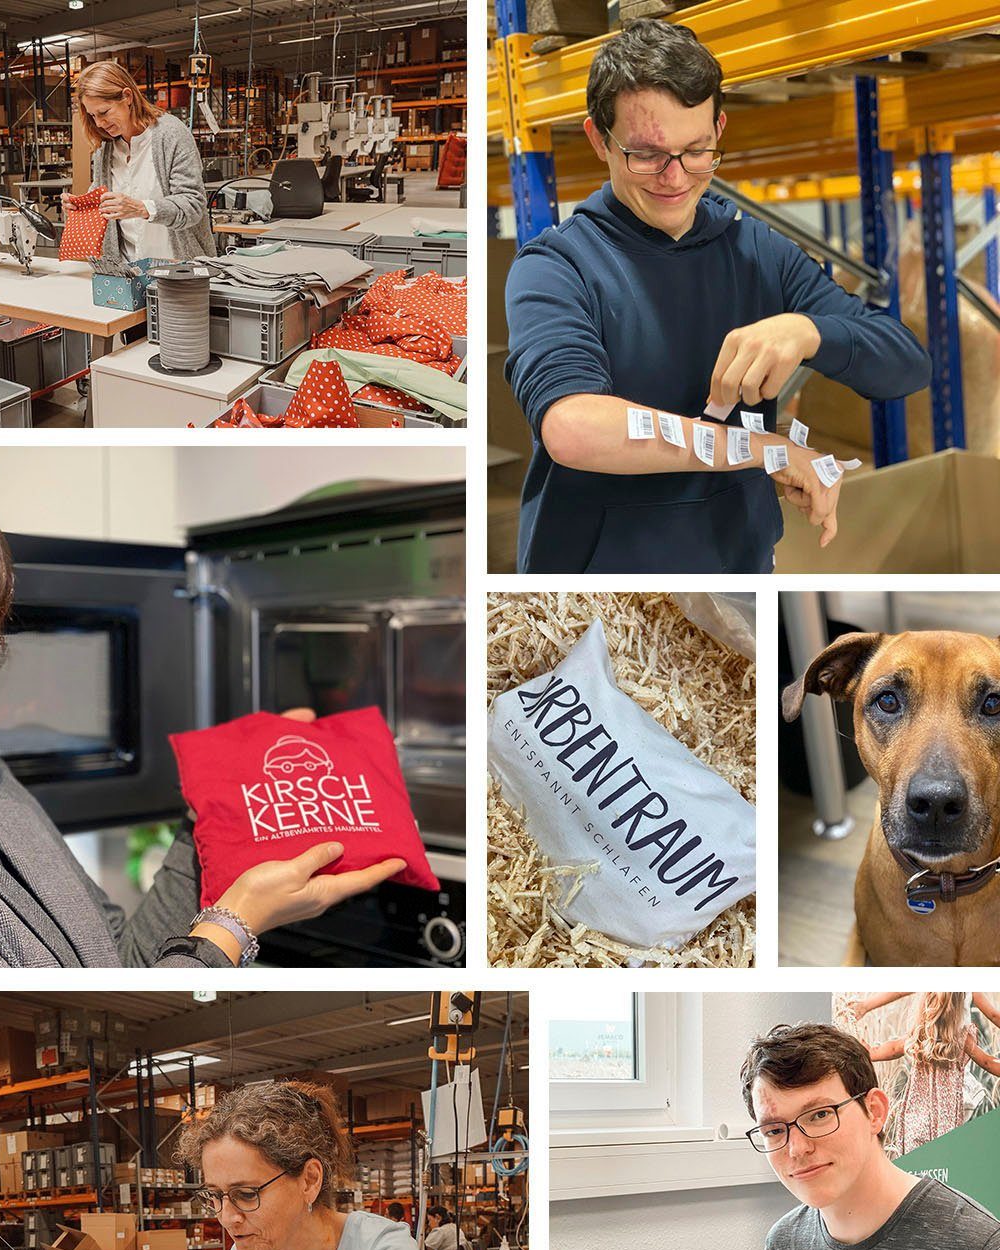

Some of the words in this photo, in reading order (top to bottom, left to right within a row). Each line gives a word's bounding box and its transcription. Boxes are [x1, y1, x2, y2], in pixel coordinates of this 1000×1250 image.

[241, 775, 371, 807] KIRSCH
[248, 799, 380, 837] KERNE
[335, 825, 383, 833] HAUSMITTEL
[504, 719, 582, 816] ENTSPANNT
[584, 822, 661, 908] SCHLAFEN
